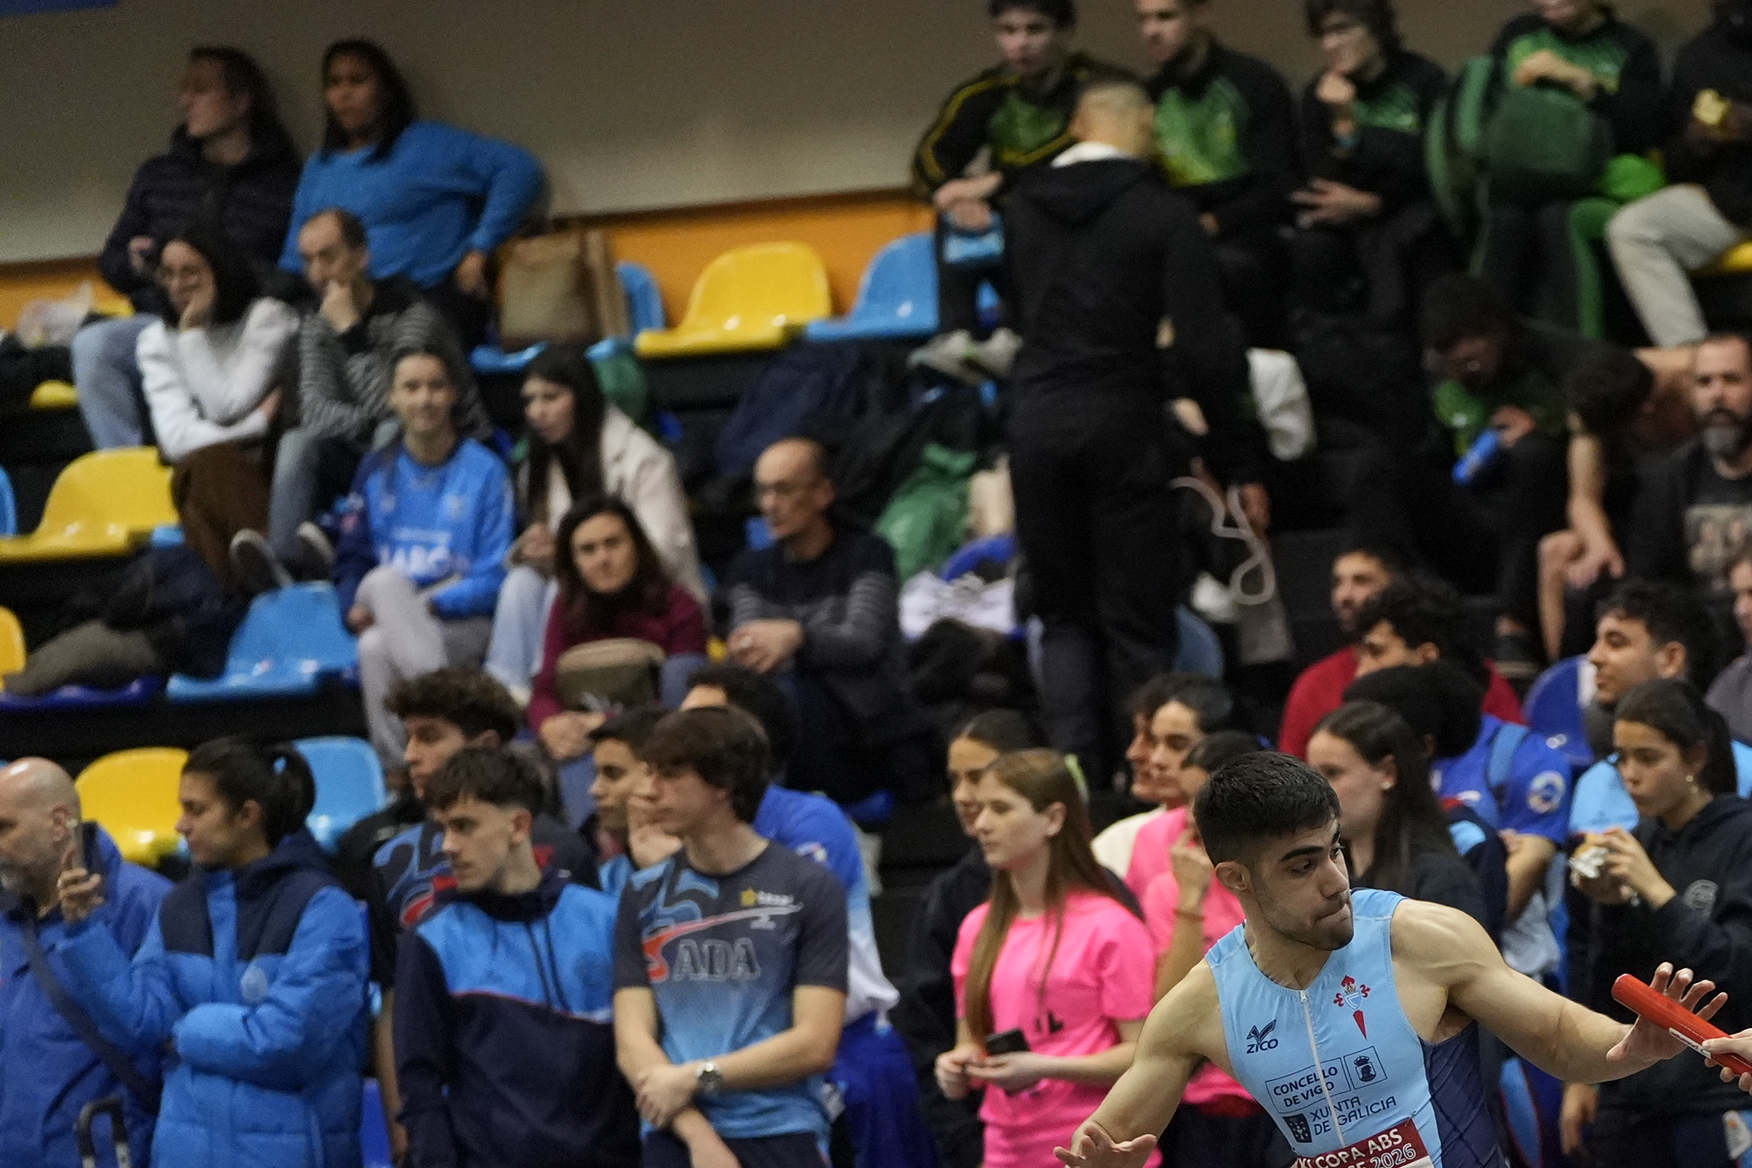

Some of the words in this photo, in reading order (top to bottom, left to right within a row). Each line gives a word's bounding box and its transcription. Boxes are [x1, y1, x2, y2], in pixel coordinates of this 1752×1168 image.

[671, 938, 762, 982] ADA
[1246, 1038, 1279, 1054] ZICO
[1273, 1066, 1338, 1096] CONCELLO
[1283, 1096, 1300, 1108] DE
[1300, 1081, 1335, 1101] VIGO
[1310, 1096, 1361, 1122] XUNTA
[1313, 1121, 1332, 1136] DE
[1337, 1096, 1397, 1126] GALICIA
[1367, 1128, 1403, 1155] ABS
